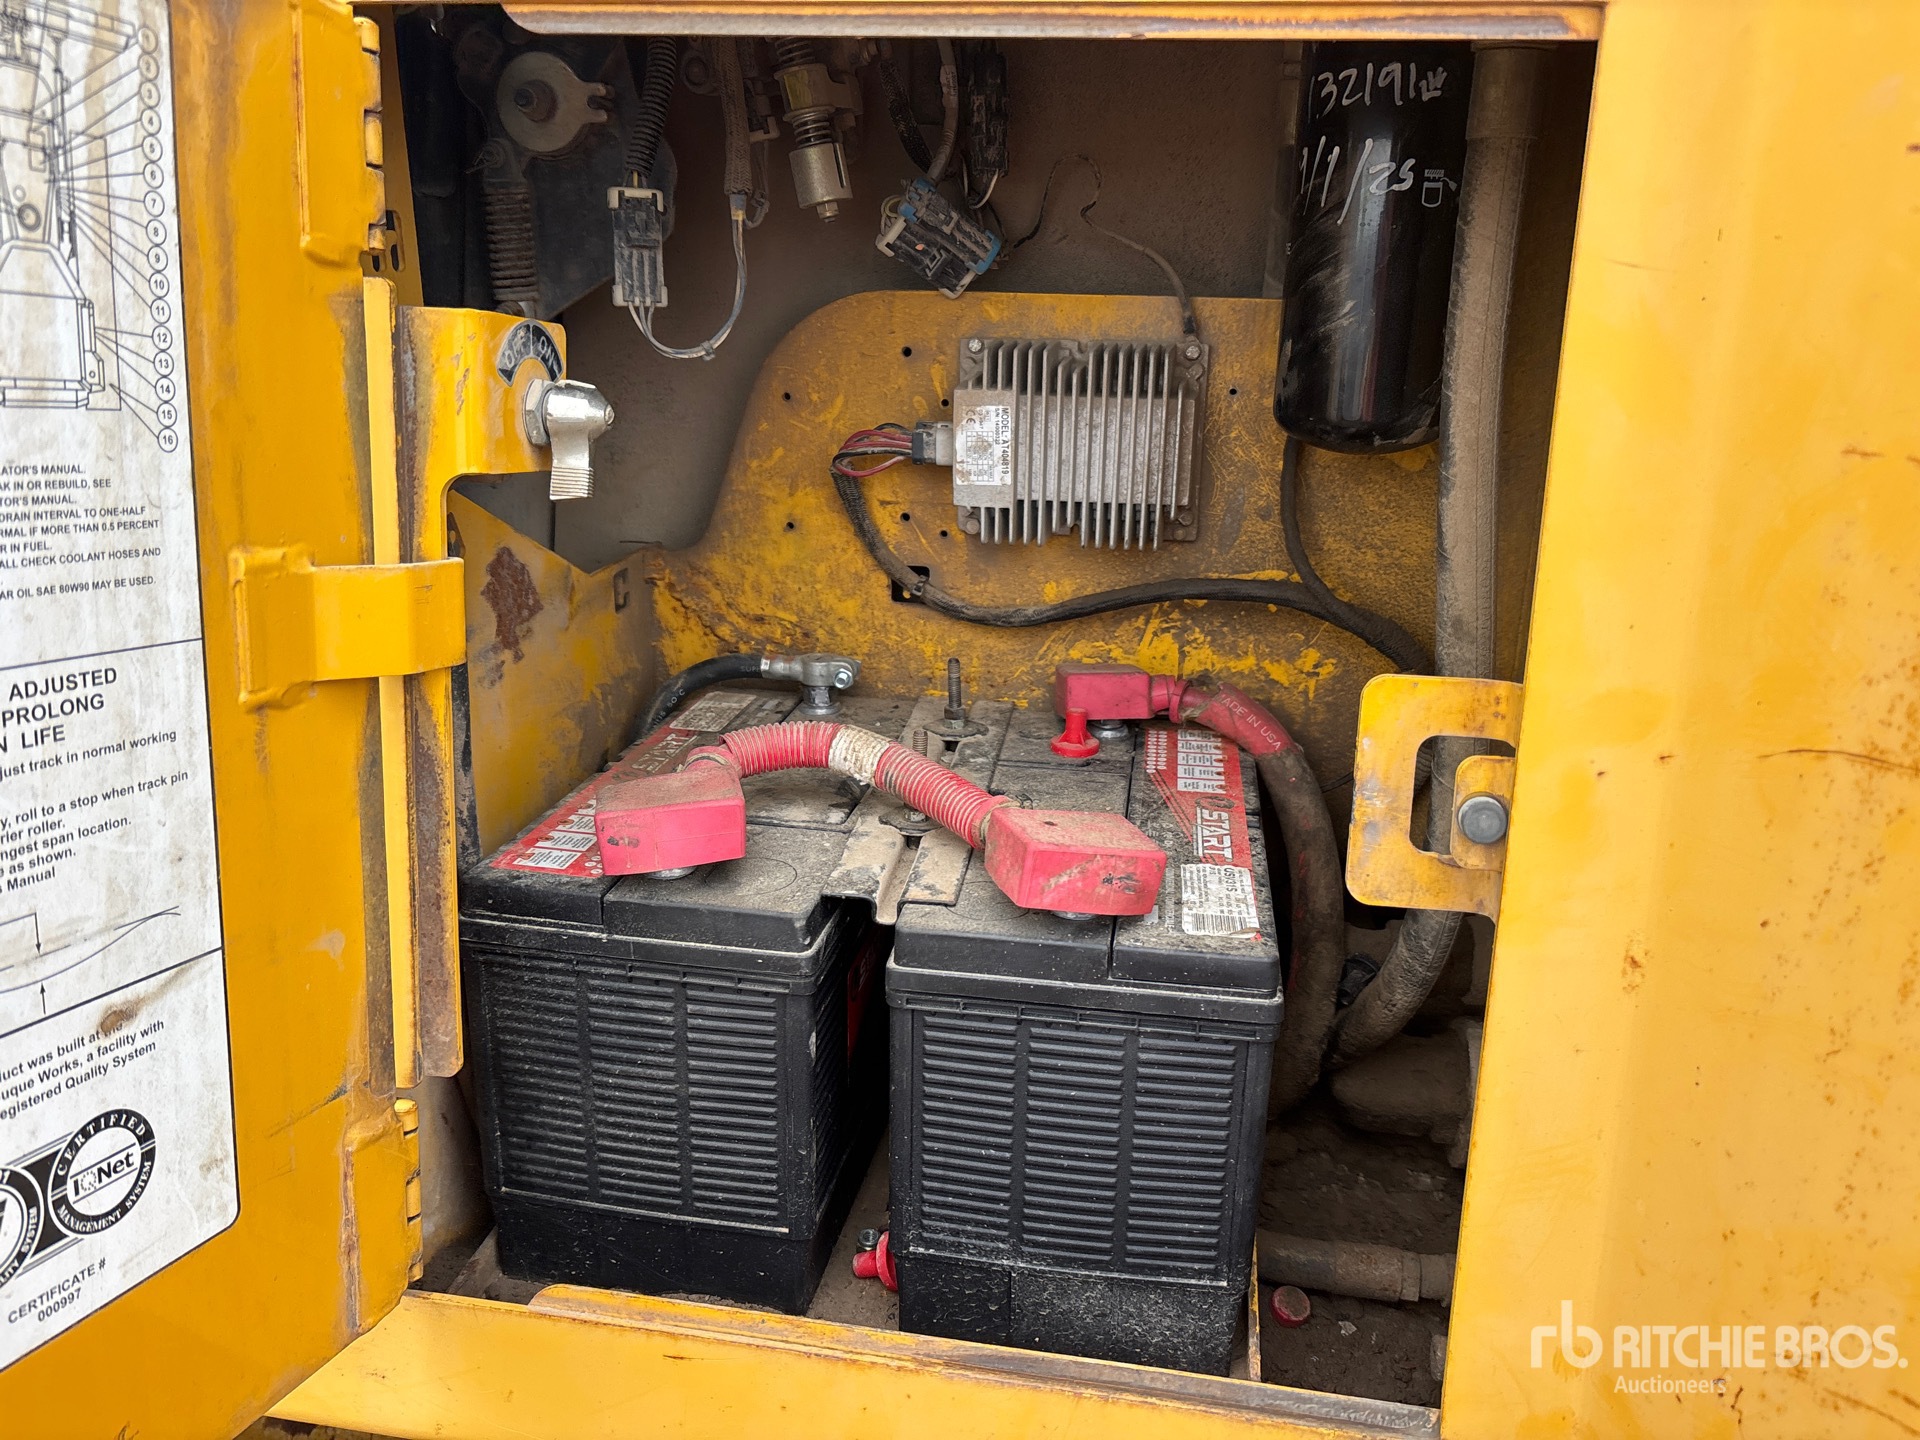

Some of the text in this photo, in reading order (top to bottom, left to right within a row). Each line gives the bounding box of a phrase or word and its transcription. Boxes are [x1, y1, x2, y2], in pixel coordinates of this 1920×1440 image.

[151, 199, 157, 210] 7
[153, 227, 159, 237] 8
[154, 253, 160, 263] 9
[154, 280, 165, 290] 10
[155, 306, 166, 316] 11
[156, 333, 168, 344] 12
[158, 359, 170, 369] 13
[160, 384, 171, 395] 14
[162, 409, 172, 420] 15
[163, 435, 174, 445] 16
[41, 464, 86, 475] MANUAL.
[13, 481, 24, 491] IN
[27, 480, 42, 490] OR
[44, 479, 91, 490] REBUILD,
[92, 479, 111, 488] SEE
[31, 495, 77, 505] MANUAL.
[33, 509, 81, 521] INTERVAL
[84, 508, 97, 518] TO
[99, 506, 147, 518] ONE-HALF
[29, 527, 38, 537] IF
[41, 525, 71, 536] MORE
[73, 523, 99, 533] THAN
[101, 522, 115, 532] 0.5
[117, 520, 159, 531] PERCENT
[10, 544, 21, 553] IN
[23, 542, 52, 552] FUEL.
[21, 555, 57, 568] CHECK
[59, 551, 106, 565] COOLANT
[108, 549, 140, 560] HOSES
[142, 547, 161, 557] AND
[16, 588, 33, 599] OIL
[36, 586, 56, 596] SAE
[59, 583, 90, 594] 80W90
[92, 581, 112, 591] MAY
[114, 579, 127, 588] BE
[129, 575, 156, 586] USED.
[9, 667, 118, 702] ADJUSTED
[2, 693, 105, 728] PROLONG
[1221, 694, 1282, 751] ADE IN USA
[21, 724, 66, 750] LIFE
[29, 752, 63, 773] track
[66, 751, 79, 764] in
[82, 740, 126, 760] normal
[129, 730, 177, 751] working
[15, 806, 38, 824] roll
[41, 805, 55, 817] to
[58, 802, 67, 813] a
[70, 793, 98, 811] stop
[101, 784, 135, 802] when
[137, 775, 168, 793] track
[170, 771, 189, 787] pin
[27, 818, 66, 838] roller.
[42, 831, 74, 853] span
[77, 816, 132, 840] location.
[1202, 807, 1233, 864] START
[8, 861, 25, 874] as
[28, 848, 77, 869] shown.
[7, 866, 56, 892] Manual
[0, 1063, 24, 1083] uct
[27, 1052, 54, 1069] was
[57, 1036, 86, 1056] built
[89, 1028, 101, 1044] at
[38, 1058, 83, 1083] Works,
[86, 1052, 94, 1062] a
[97, 1032, 137, 1058] facility
[140, 1019, 165, 1038] with
[65, 1063, 109, 1090] Quality
[112, 1041, 156, 1068] System
[57, 1112, 146, 1176] CERTIFIED
[57, 1161, 151, 1233] MANAGEMENT SYSTEM
[8, 1263, 96, 1325] CERTIFICATE
[37, 1287, 82, 1322] 000997
